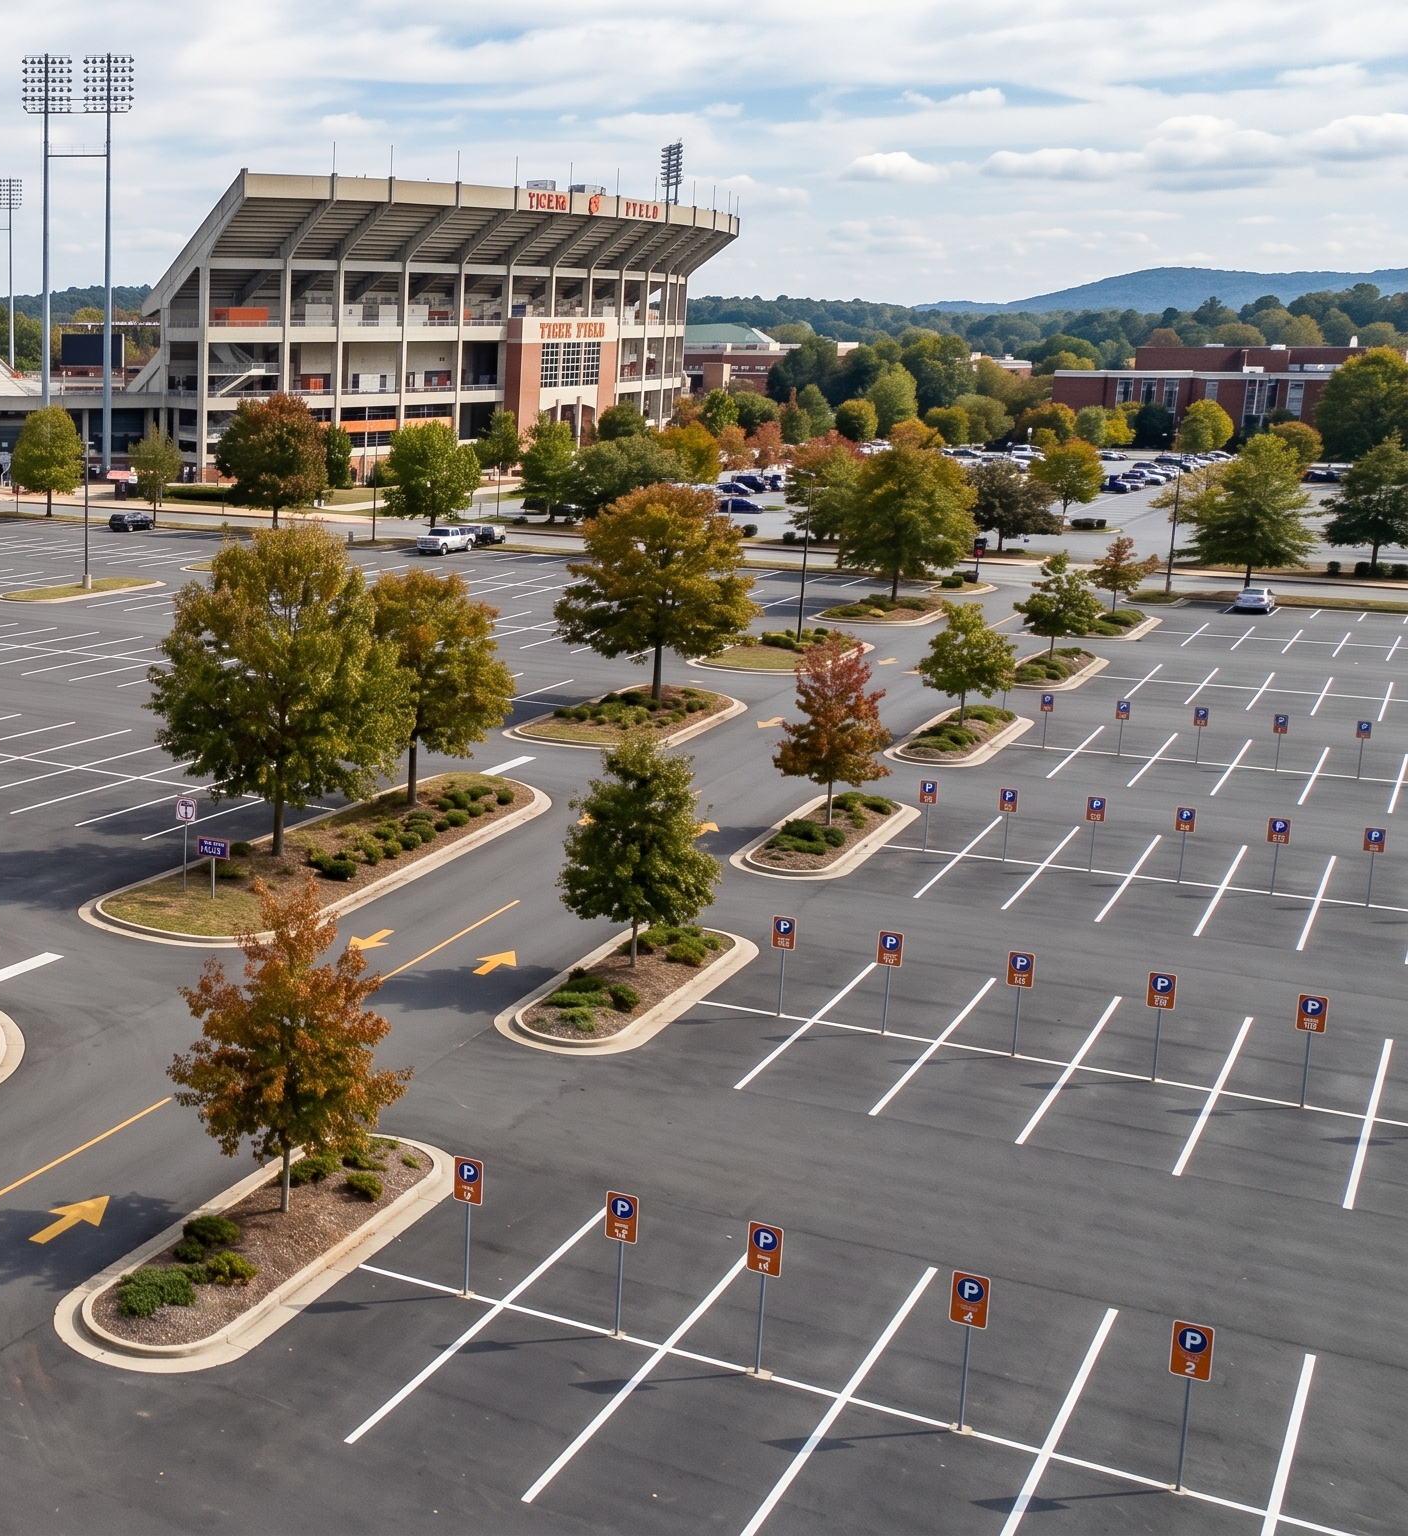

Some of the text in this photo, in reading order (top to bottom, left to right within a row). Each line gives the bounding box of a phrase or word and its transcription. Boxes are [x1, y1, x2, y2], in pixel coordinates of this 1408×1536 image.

[780, 920, 790, 932] P
[886, 936, 897, 949] P
[1016, 957, 1027, 970] P
[1157, 977, 1169, 990] P
[1307, 1000, 1320, 1013] P
[463, 1165, 474, 1180] P
[617, 1200, 629, 1215] P
[759, 1231, 773, 1247] P
[964, 1281, 979, 1298] P
[1185, 1331, 1202, 1349] P
[1184, 1361, 1196, 1375] 2
